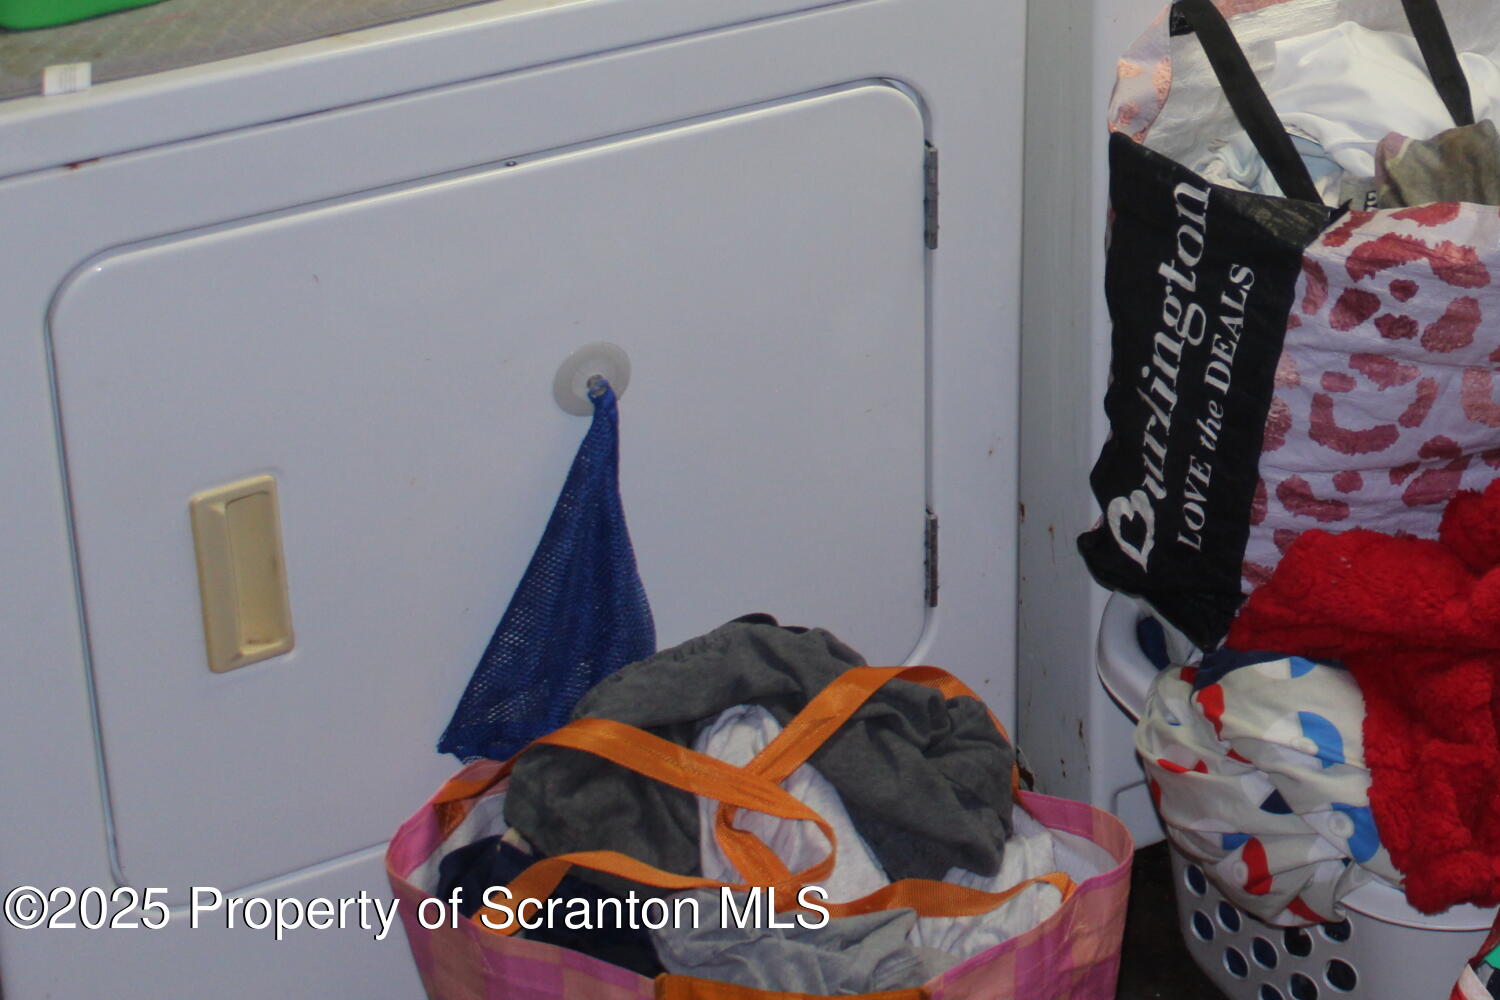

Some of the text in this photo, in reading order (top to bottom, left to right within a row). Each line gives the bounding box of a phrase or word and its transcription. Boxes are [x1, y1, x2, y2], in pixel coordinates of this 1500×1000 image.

[1106, 181, 1211, 574] Burlington
[1176, 263, 1255, 552] LOVE the DEALS
